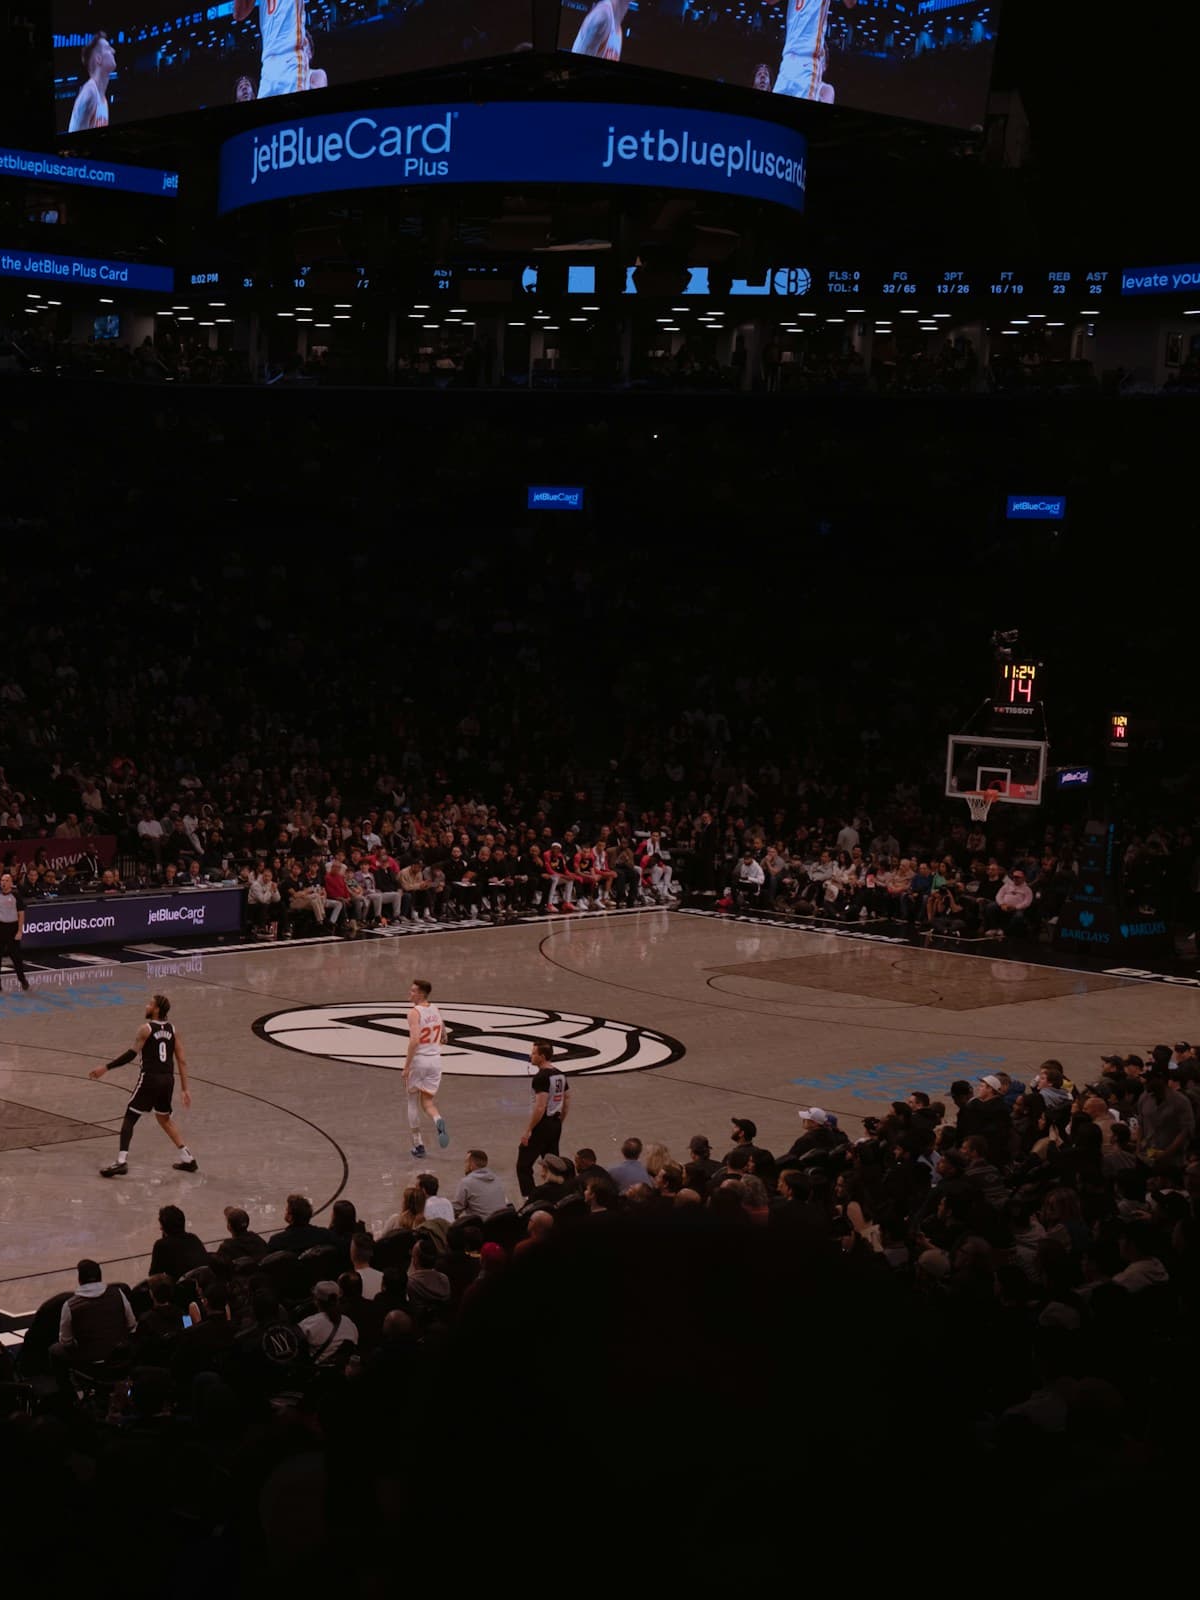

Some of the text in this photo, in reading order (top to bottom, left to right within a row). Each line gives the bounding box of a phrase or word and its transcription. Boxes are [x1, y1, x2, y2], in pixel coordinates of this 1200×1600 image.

[251, 112, 453, 184] jetBlueCard
[404, 157, 449, 178] Plus
[0, 255, 22, 272] the
[23, 257, 70, 277] JetBlue
[72, 261, 97, 280] Plus
[99, 265, 128, 282] Card
[892, 271, 908, 281] FG
[943, 271, 965, 281] 3PT
[1000, 271, 1015, 281] FT
[1048, 271, 1071, 281] REB
[1086, 271, 1108, 281] AST
[852, 283, 860, 293] 4
[1052, 284, 1066, 294] 23
[1089, 284, 1103, 294] 25
[1003, 664, 1036, 680] 11:24
[1010, 679, 1033, 703] 14
[147, 905, 206, 925] jetBlueCard
[22, 914, 115, 935] uecardplus.com
[420, 1024, 441, 1044] 27
